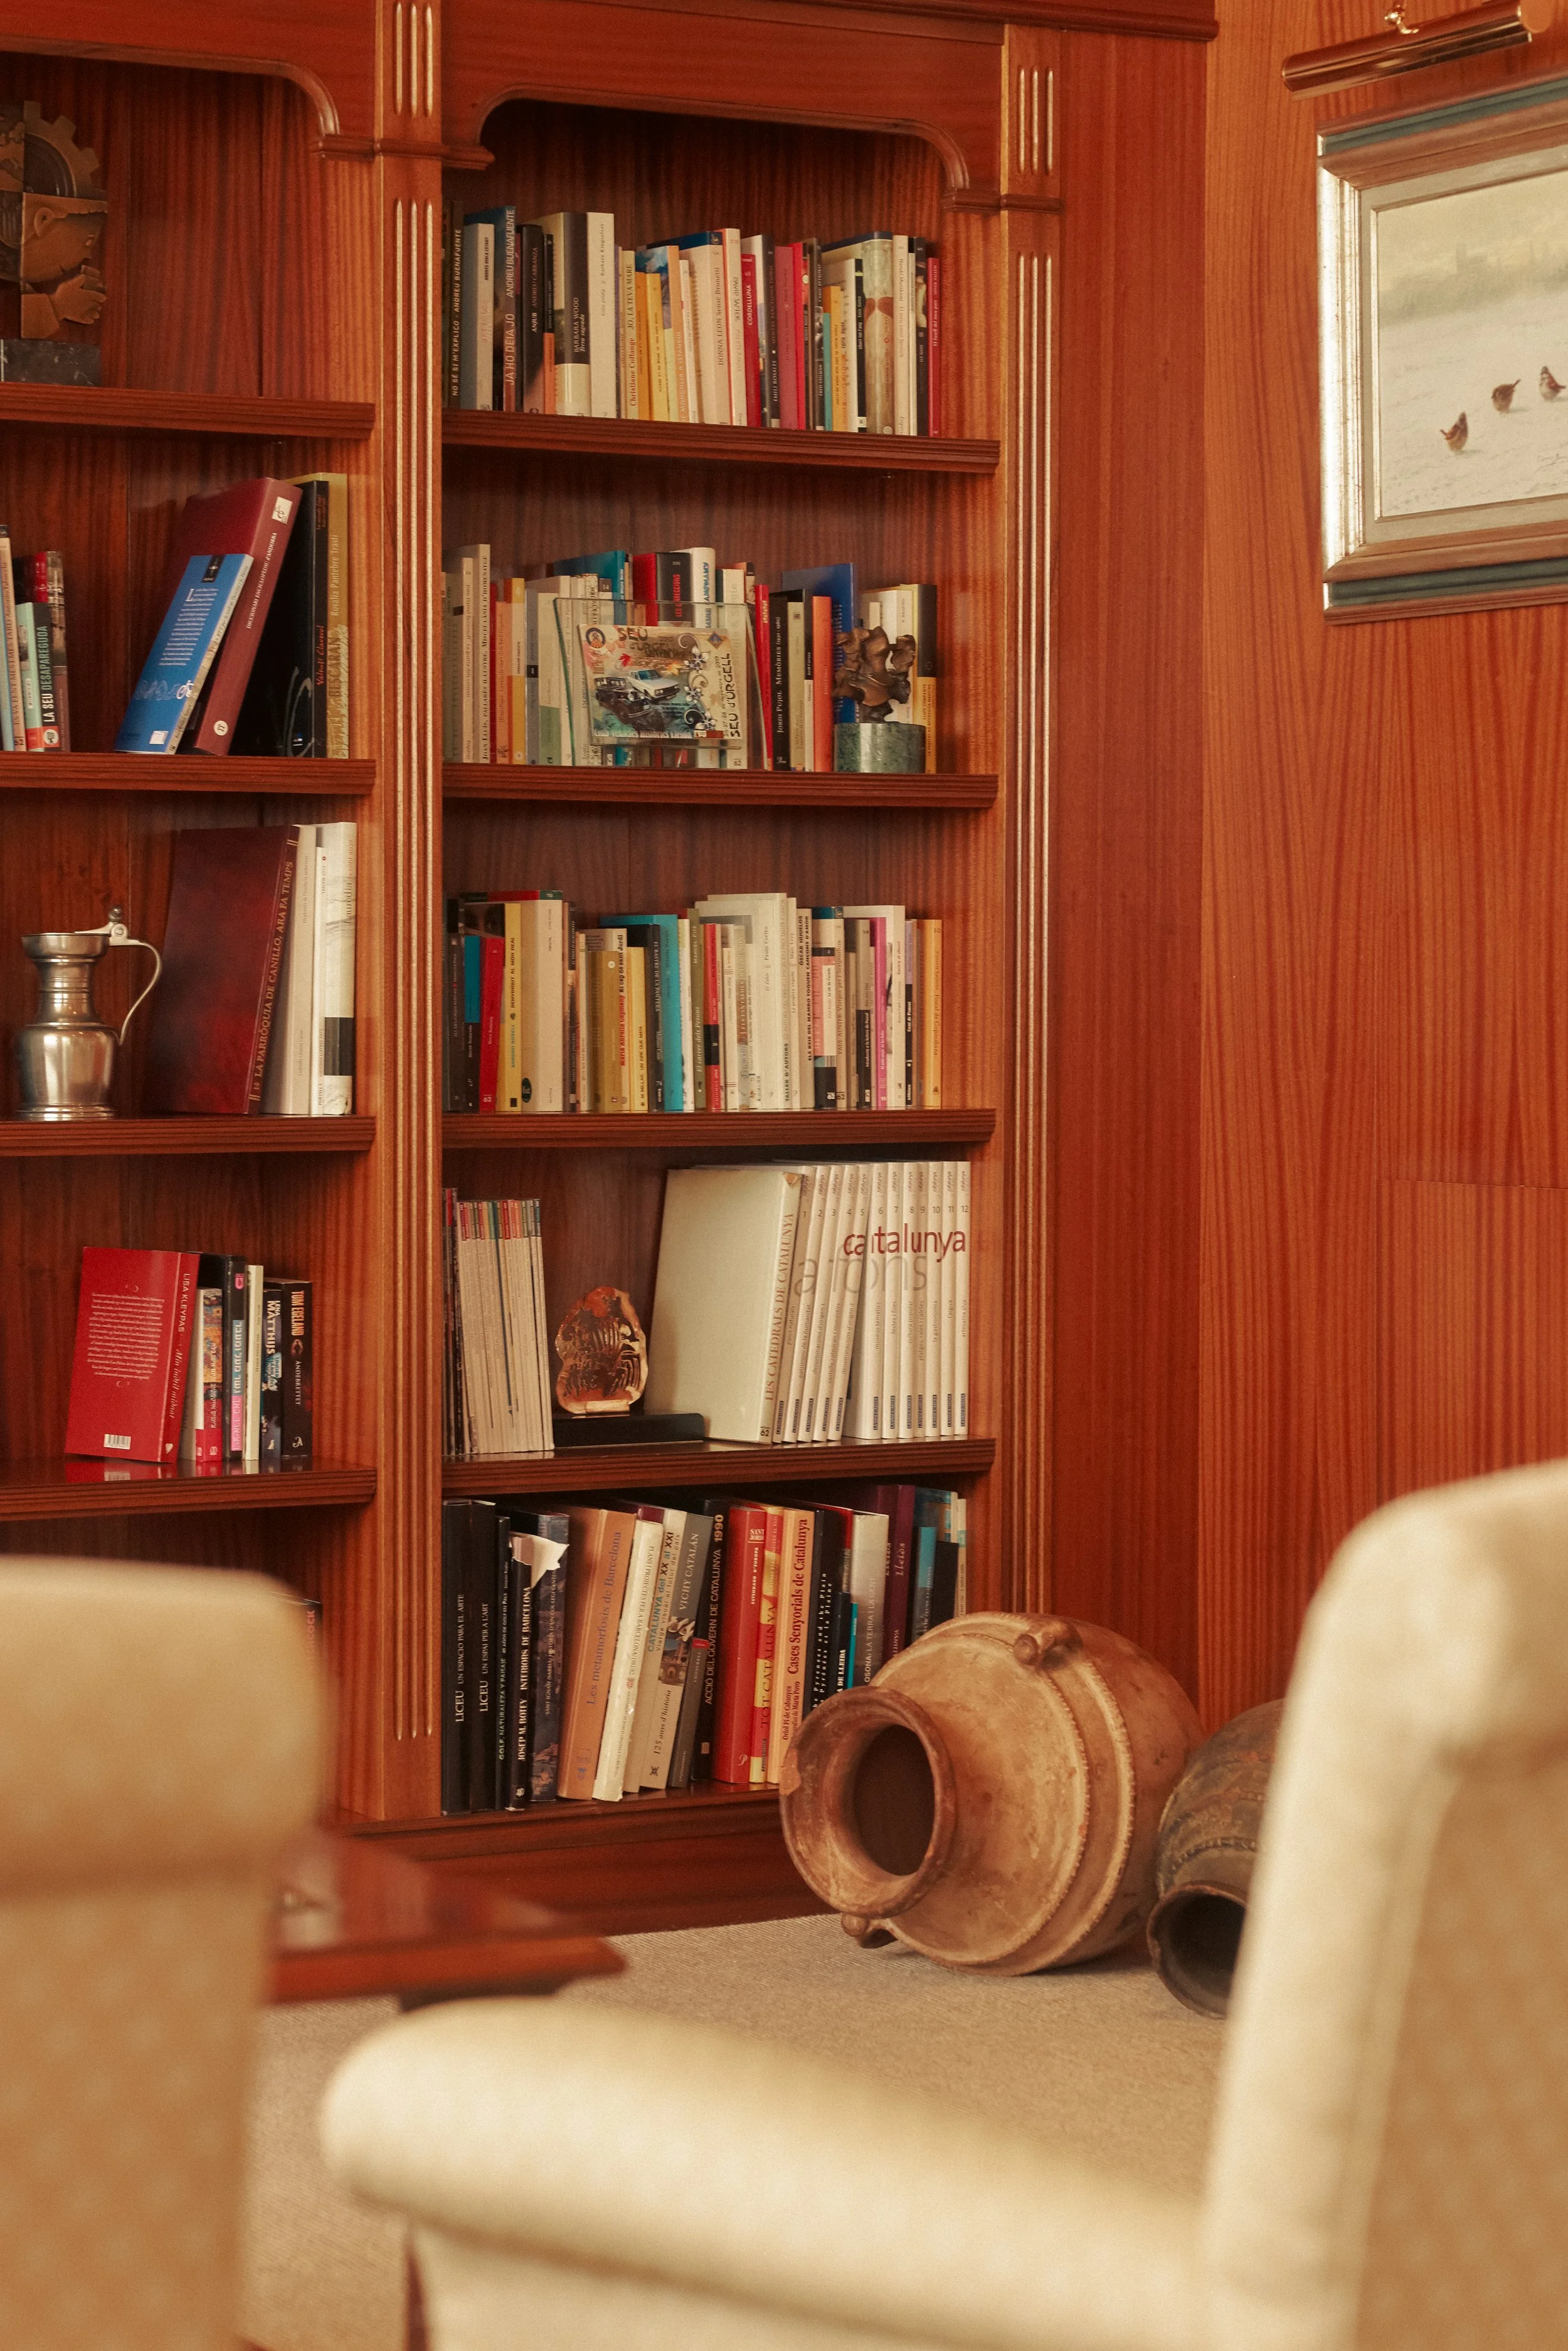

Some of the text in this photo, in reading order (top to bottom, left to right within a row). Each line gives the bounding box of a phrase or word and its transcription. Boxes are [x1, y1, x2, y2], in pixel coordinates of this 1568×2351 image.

[506, 210, 514, 385] JA HO DEIA JO ANDREU BUENAFUENTE
[628, 307, 634, 316] LA
[452, 386, 458, 396] NO
[453, 374, 458, 383] SÉ
[246, 533, 277, 629] DICCIONARI ENCICLOPÈDIC d'ANDORRA
[672, 575, 682, 607] CORRECCIONS
[37, 626, 55, 721] LA SEU DESAPAREGUDA
[328, 637, 340, 698] BESCARAN
[721, 653, 740, 737] SEU d'URGELL
[254, 862, 293, 1077] LA PARRÒQUIA DE CANILLO, ARA FA TEMPS
[844, 1224, 965, 1262] catalunya
[178, 1294, 188, 1332] KLEYPAS
[291, 1291, 304, 1335] TOM EGELAND
[766, 1214, 793, 1400] LES CATEDRALS DE CATALUNYA
[666, 1568, 675, 1588] futur
[680, 1533, 698, 1610] VICHY CATALÁN
[648, 1532, 674, 1652] CATALUNYA del XX al XXI
[706, 1515, 723, 1704] ACCIÓ DEL GOVERN DE CATALUNYA 1990
[788, 1519, 807, 1674] Cases Senyorials de Catalunya
[867, 1600, 874, 1608] LA
[457, 1614, 464, 1622] EL
[586, 1532, 620, 1704] Les metamorfosis de Barcelona
[660, 1601, 670, 1624] visual
[656, 1628, 666, 1651] Viatge
[866, 1643, 872, 1652] LA
[457, 1674, 464, 1684] UN
[482, 1664, 489, 1674] UN
[518, 1587, 531, 1760] JOSEP M. BOTEY INTERIORS DE BARCELONA
[760, 1605, 775, 1728] TOT CATALUNYA
[837, 1650, 846, 1685] DE LLEIDA
[864, 1653, 872, 1682] OSONA:
[455, 1690, 464, 1721] LICEU
[480, 1680, 489, 1711] LICEU
[654, 1690, 672, 1754] 125 anys d'història
